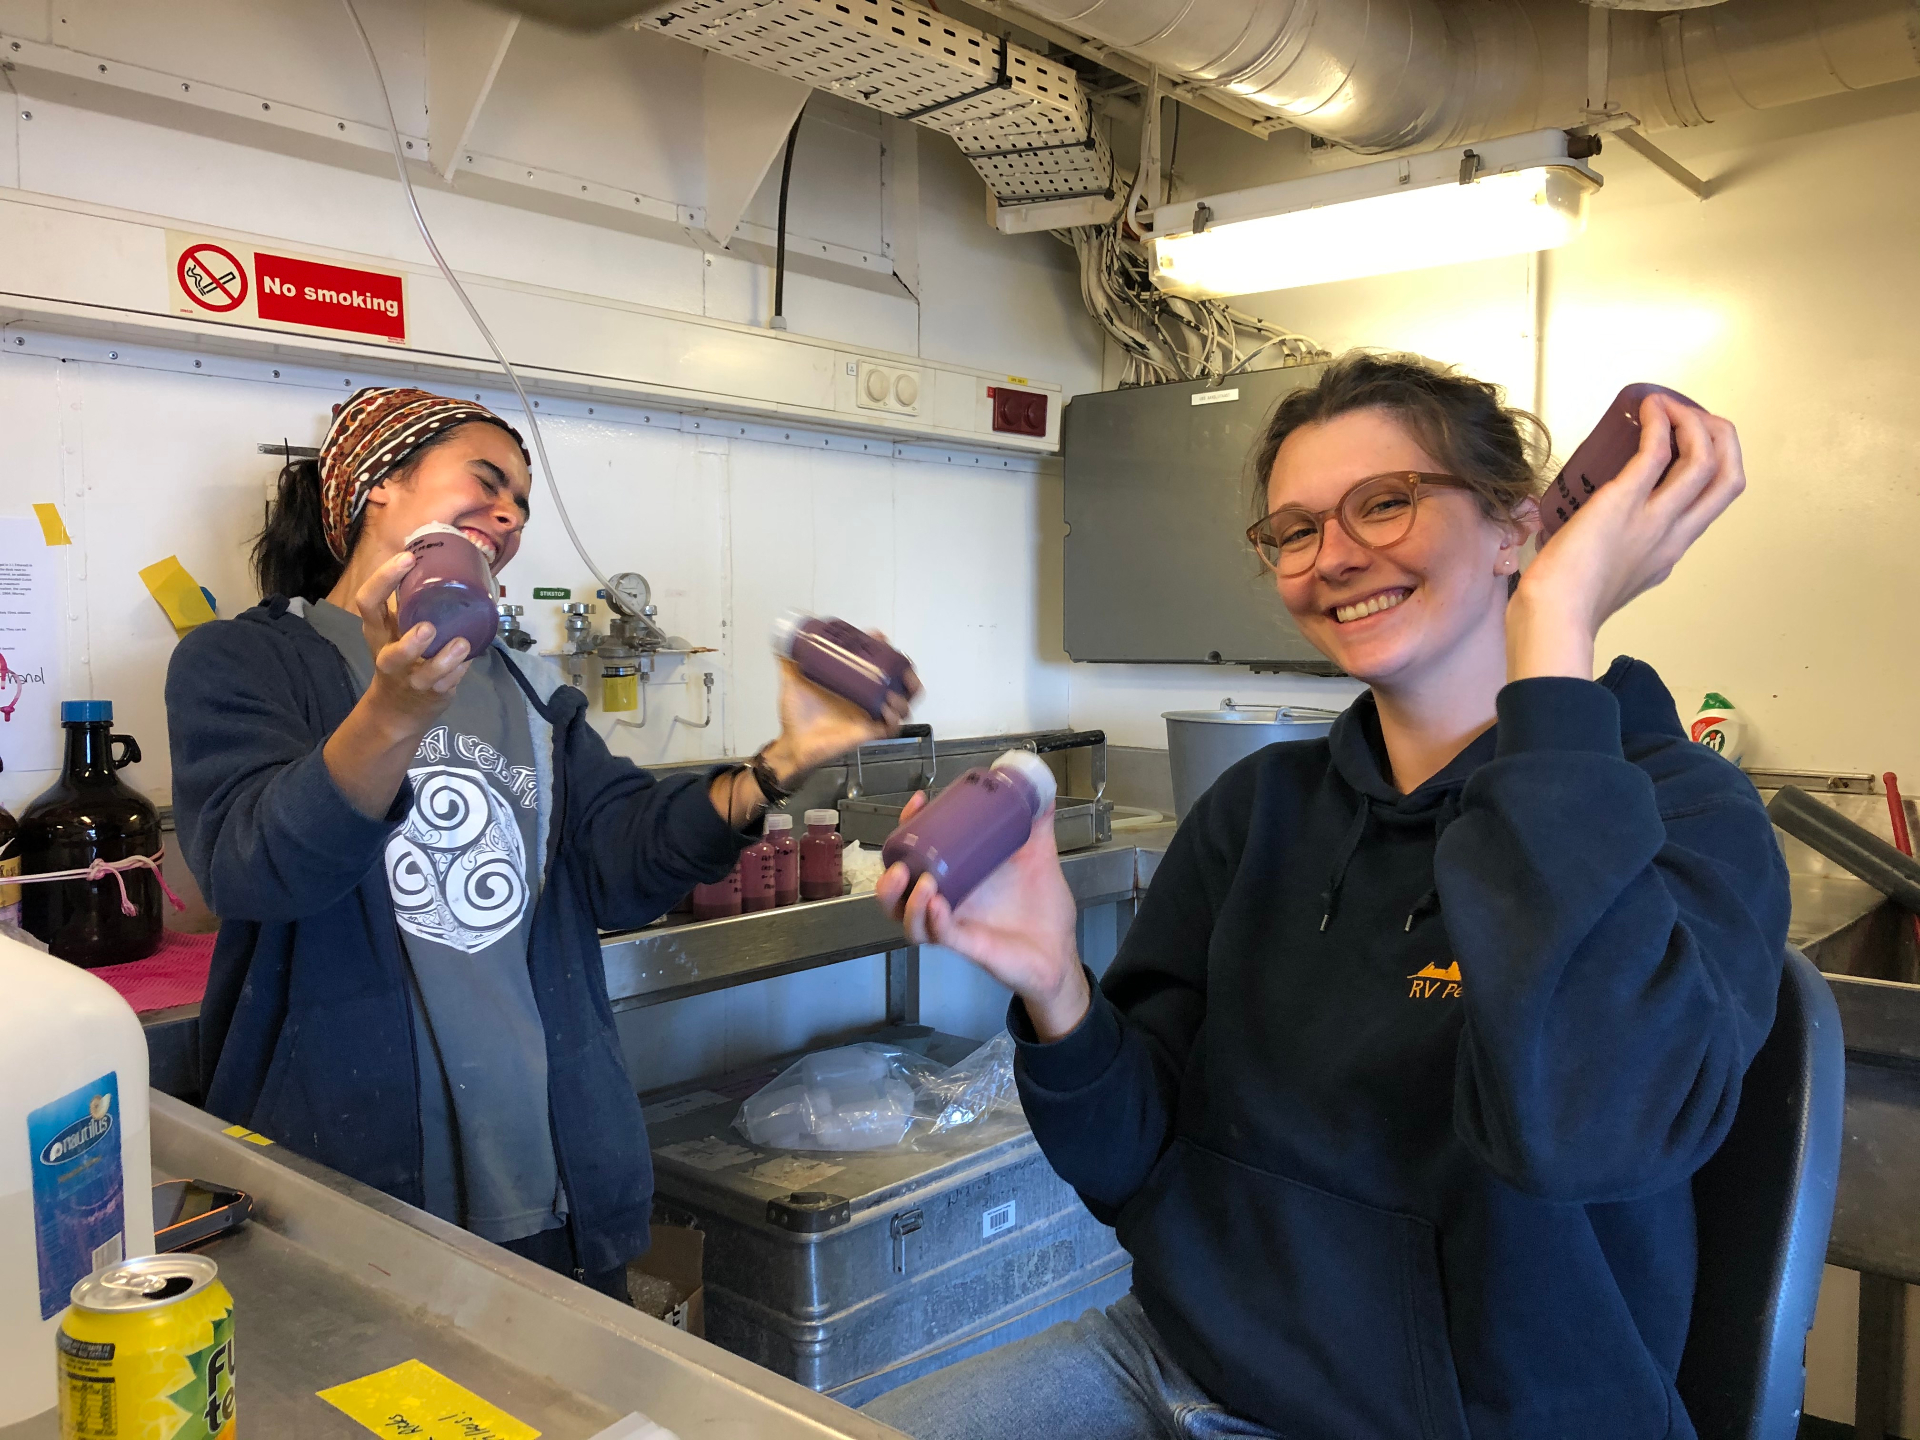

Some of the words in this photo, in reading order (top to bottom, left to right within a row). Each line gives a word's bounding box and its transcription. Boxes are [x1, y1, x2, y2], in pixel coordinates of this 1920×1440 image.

[262, 275, 297, 298] No
[303, 285, 399, 318] smoking
[1408, 979, 1441, 999] RV
[63, 1116, 109, 1154] nautilus
